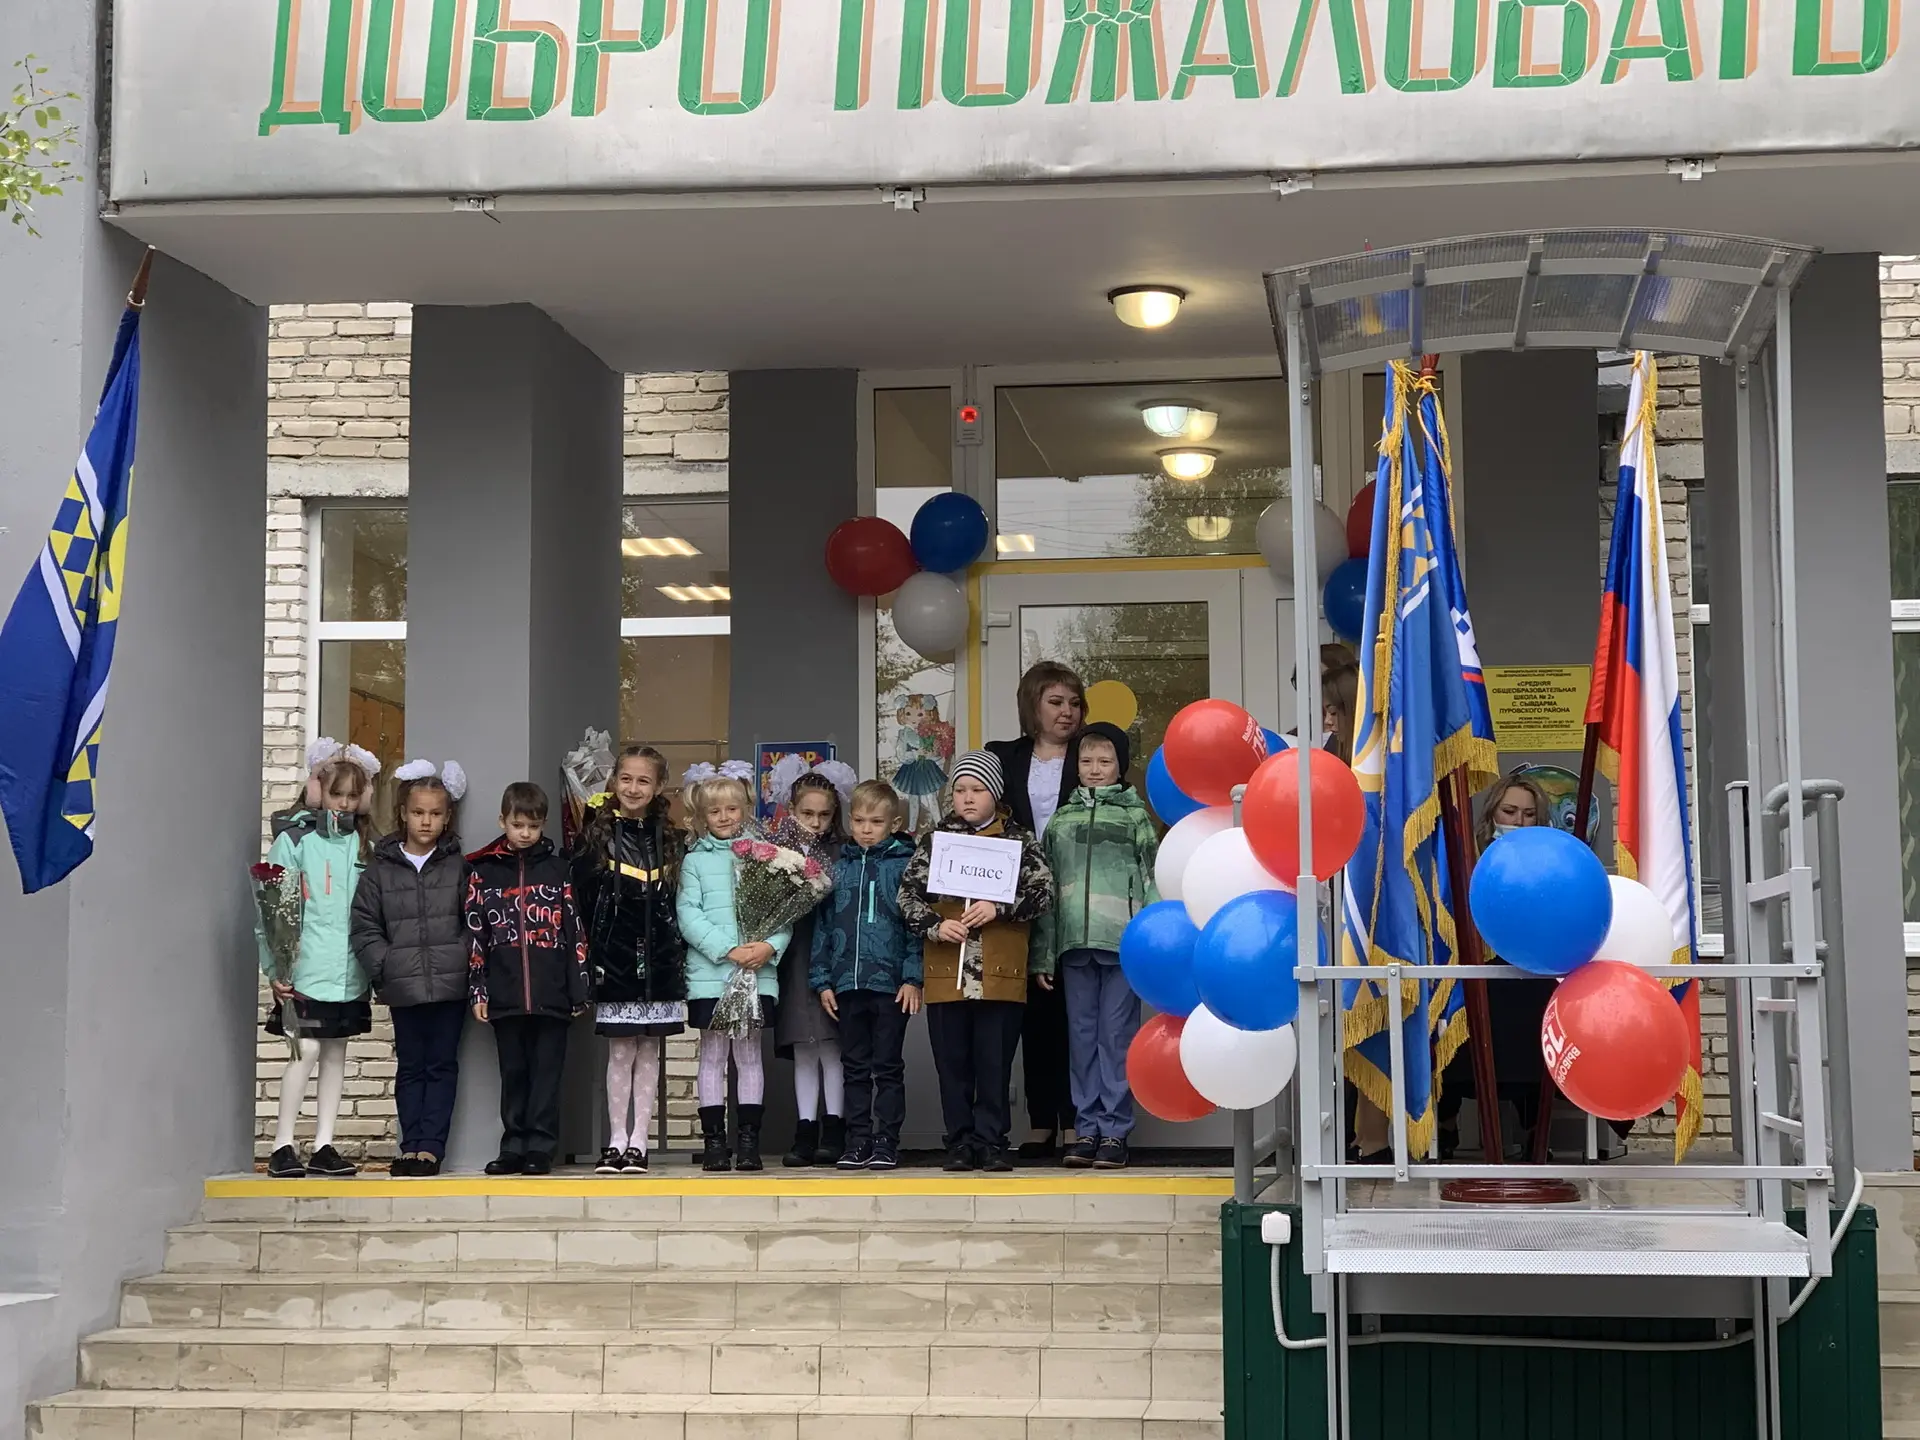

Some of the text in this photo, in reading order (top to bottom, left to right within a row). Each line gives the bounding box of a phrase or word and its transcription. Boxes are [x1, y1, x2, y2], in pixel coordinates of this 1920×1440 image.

[258, 0, 781, 136] ДОБРО
[948, 860, 1003, 880] 1 класс
